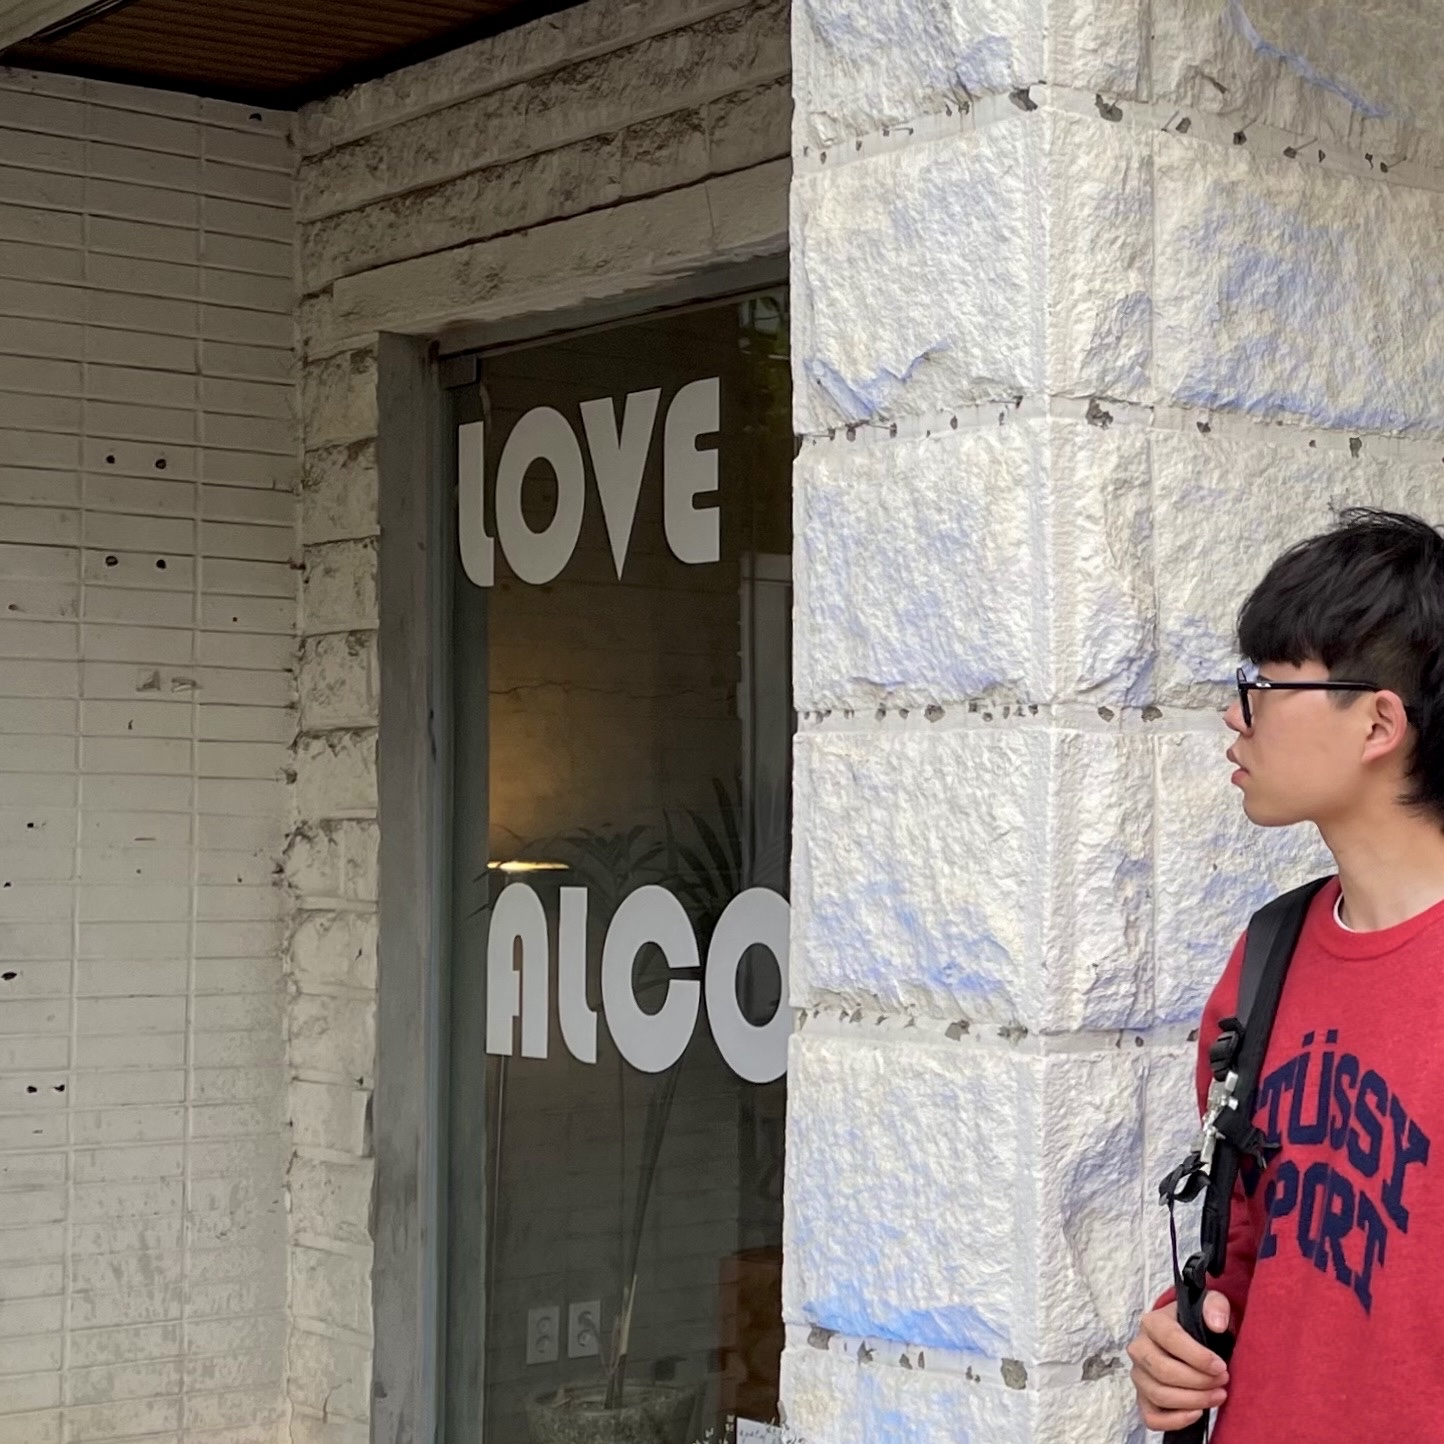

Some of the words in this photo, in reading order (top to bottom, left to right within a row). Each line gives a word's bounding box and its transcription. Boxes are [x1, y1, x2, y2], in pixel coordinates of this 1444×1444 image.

[458, 376, 720, 588] LOVE
[486, 882, 792, 1084] ALCO
[1253, 1029, 1431, 1234] TÜSSY
[1250, 1159, 1388, 1315] PORT
